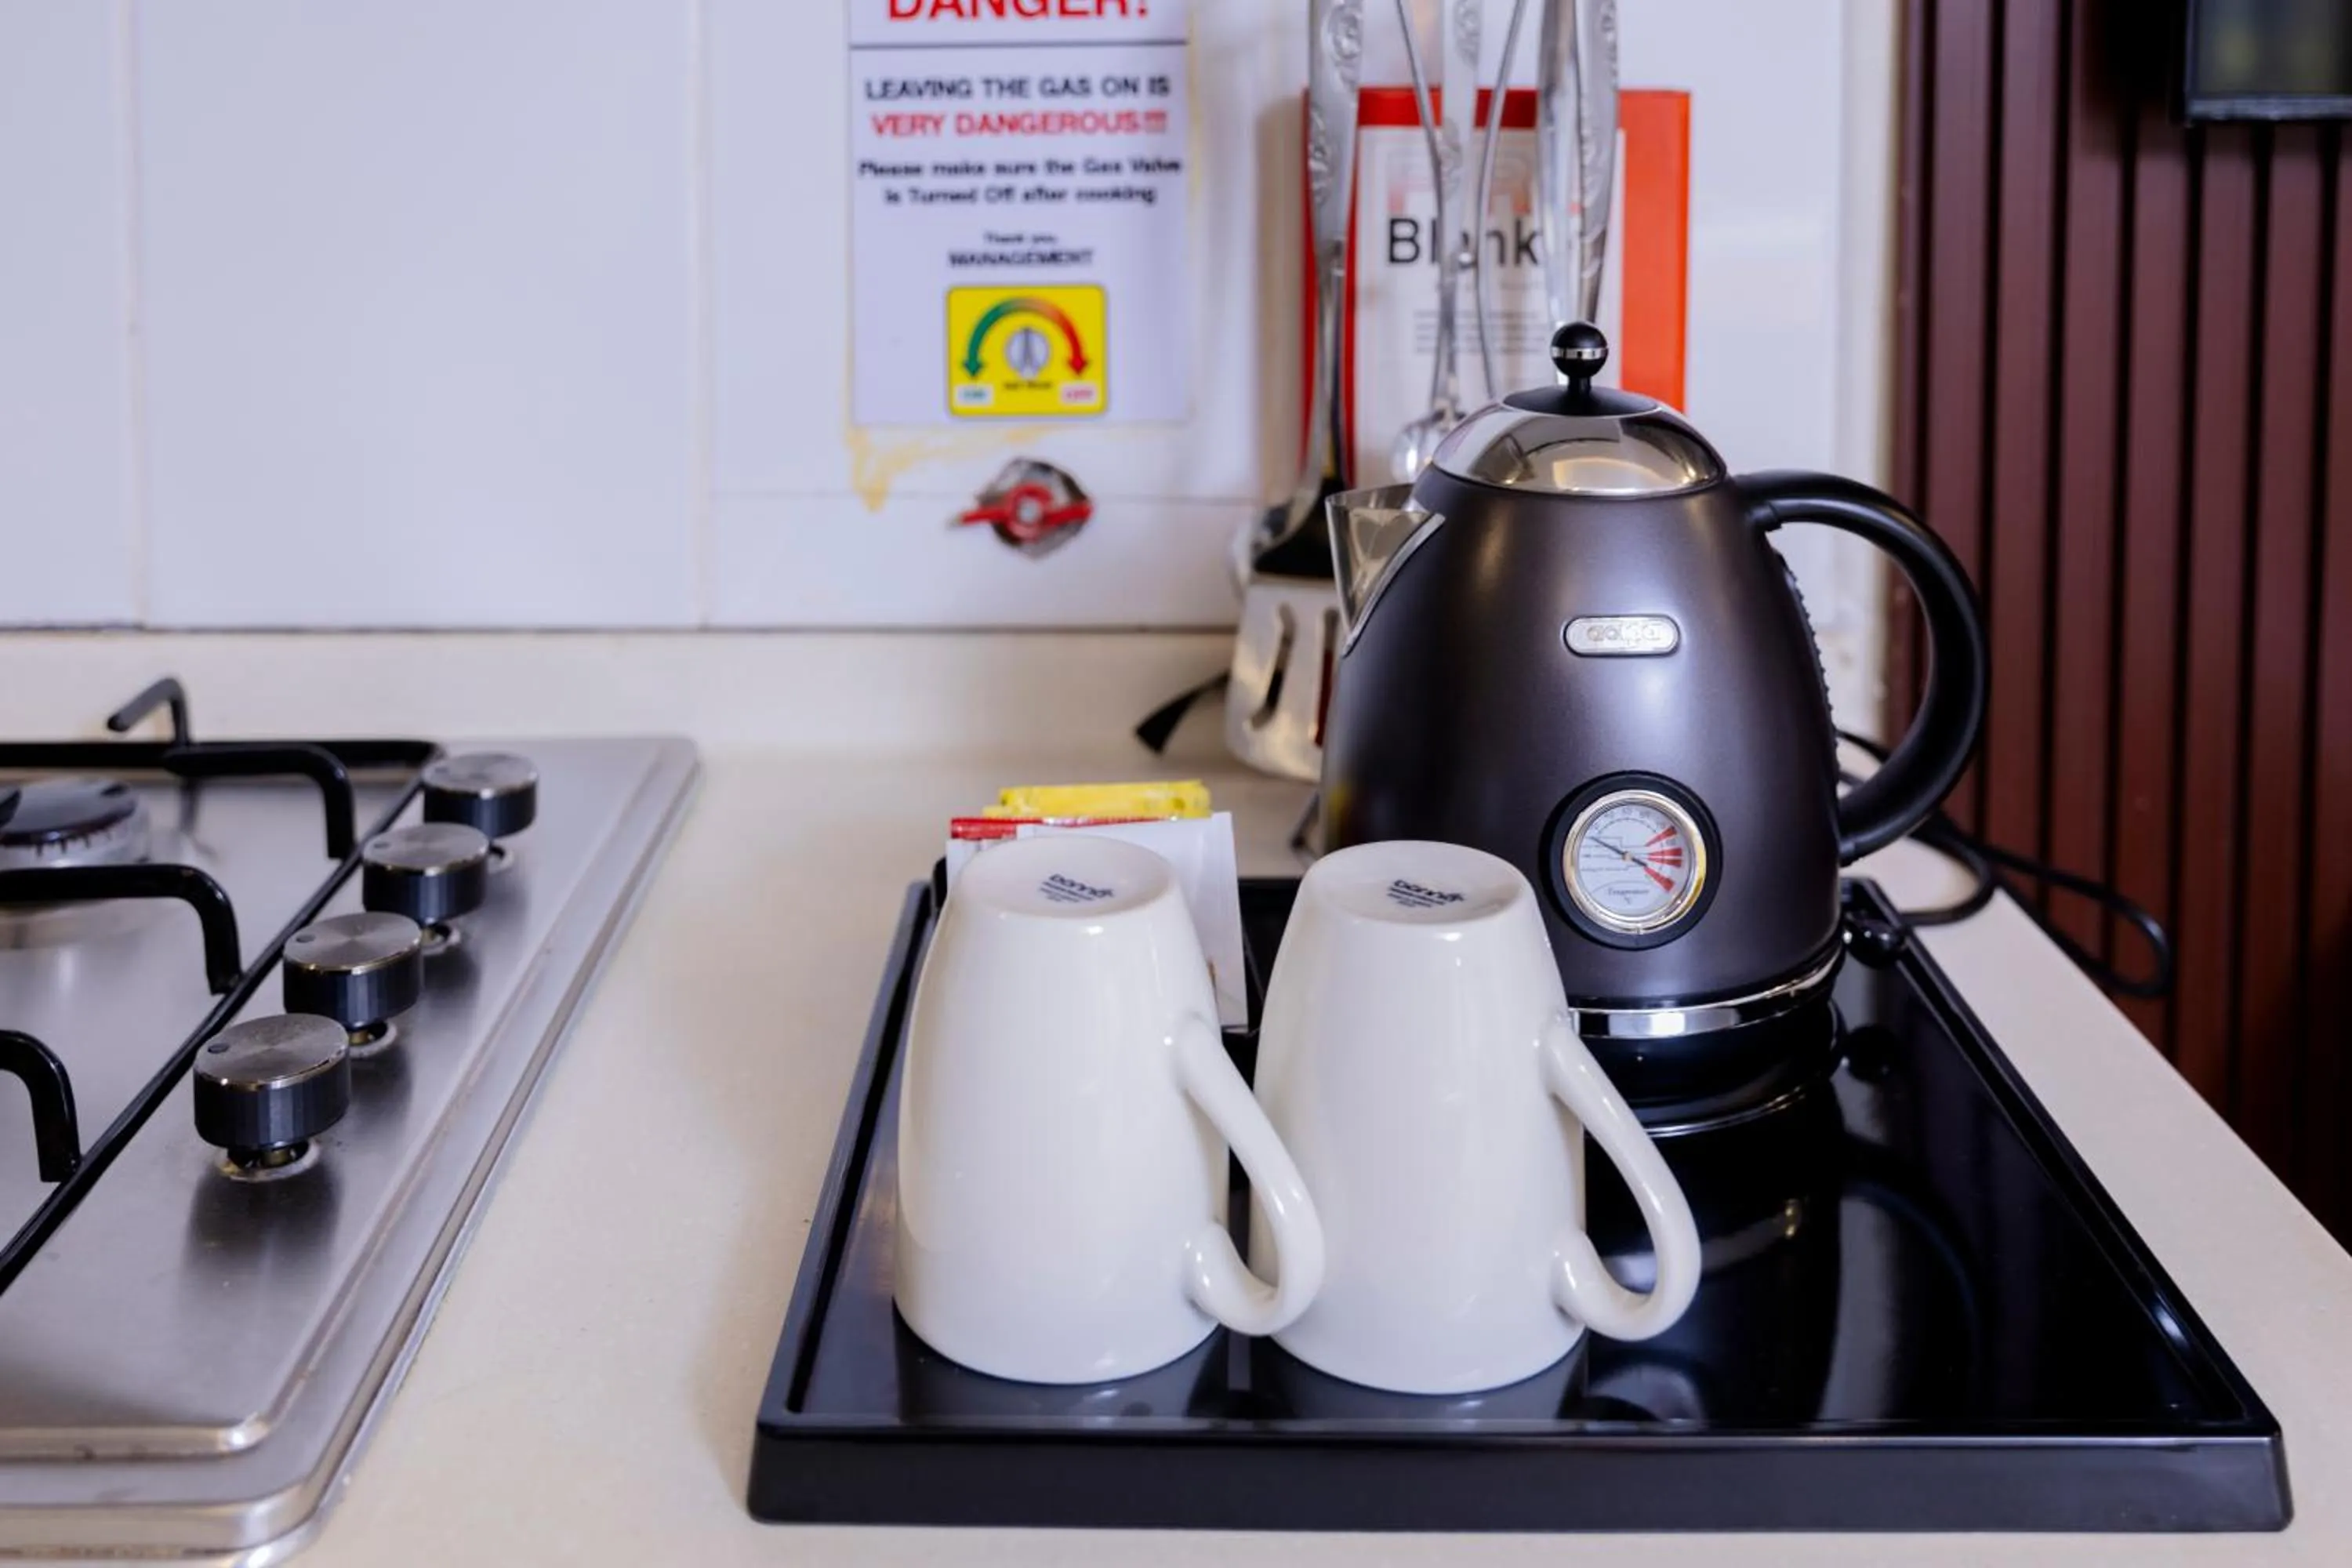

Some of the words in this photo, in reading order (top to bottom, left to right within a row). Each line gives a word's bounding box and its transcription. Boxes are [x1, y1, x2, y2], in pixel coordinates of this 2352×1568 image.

[866, 78, 973, 100] LEAVING
[982, 77, 1029, 99] THE
[1039, 77, 1091, 98] GAS
[1102, 76, 1139, 97] ON
[1148, 75, 1170, 96] IS
[872, 112, 946, 136] VERY
[858, 159, 923, 176] Please
[931, 160, 985, 176] make
[994, 162, 1036, 175] sure
[1044, 159, 1075, 174] the
[1083, 158, 1123, 174] Gas
[1131, 158, 1181, 173] Valve
[885, 188, 901, 204] is
[909, 187, 977, 204] Turned
[984, 186, 1015, 203] Off
[1022, 186, 1067, 201] after
[1075, 186, 1156, 206] cooking
[949, 250, 1092, 267] MANAGEMENT
